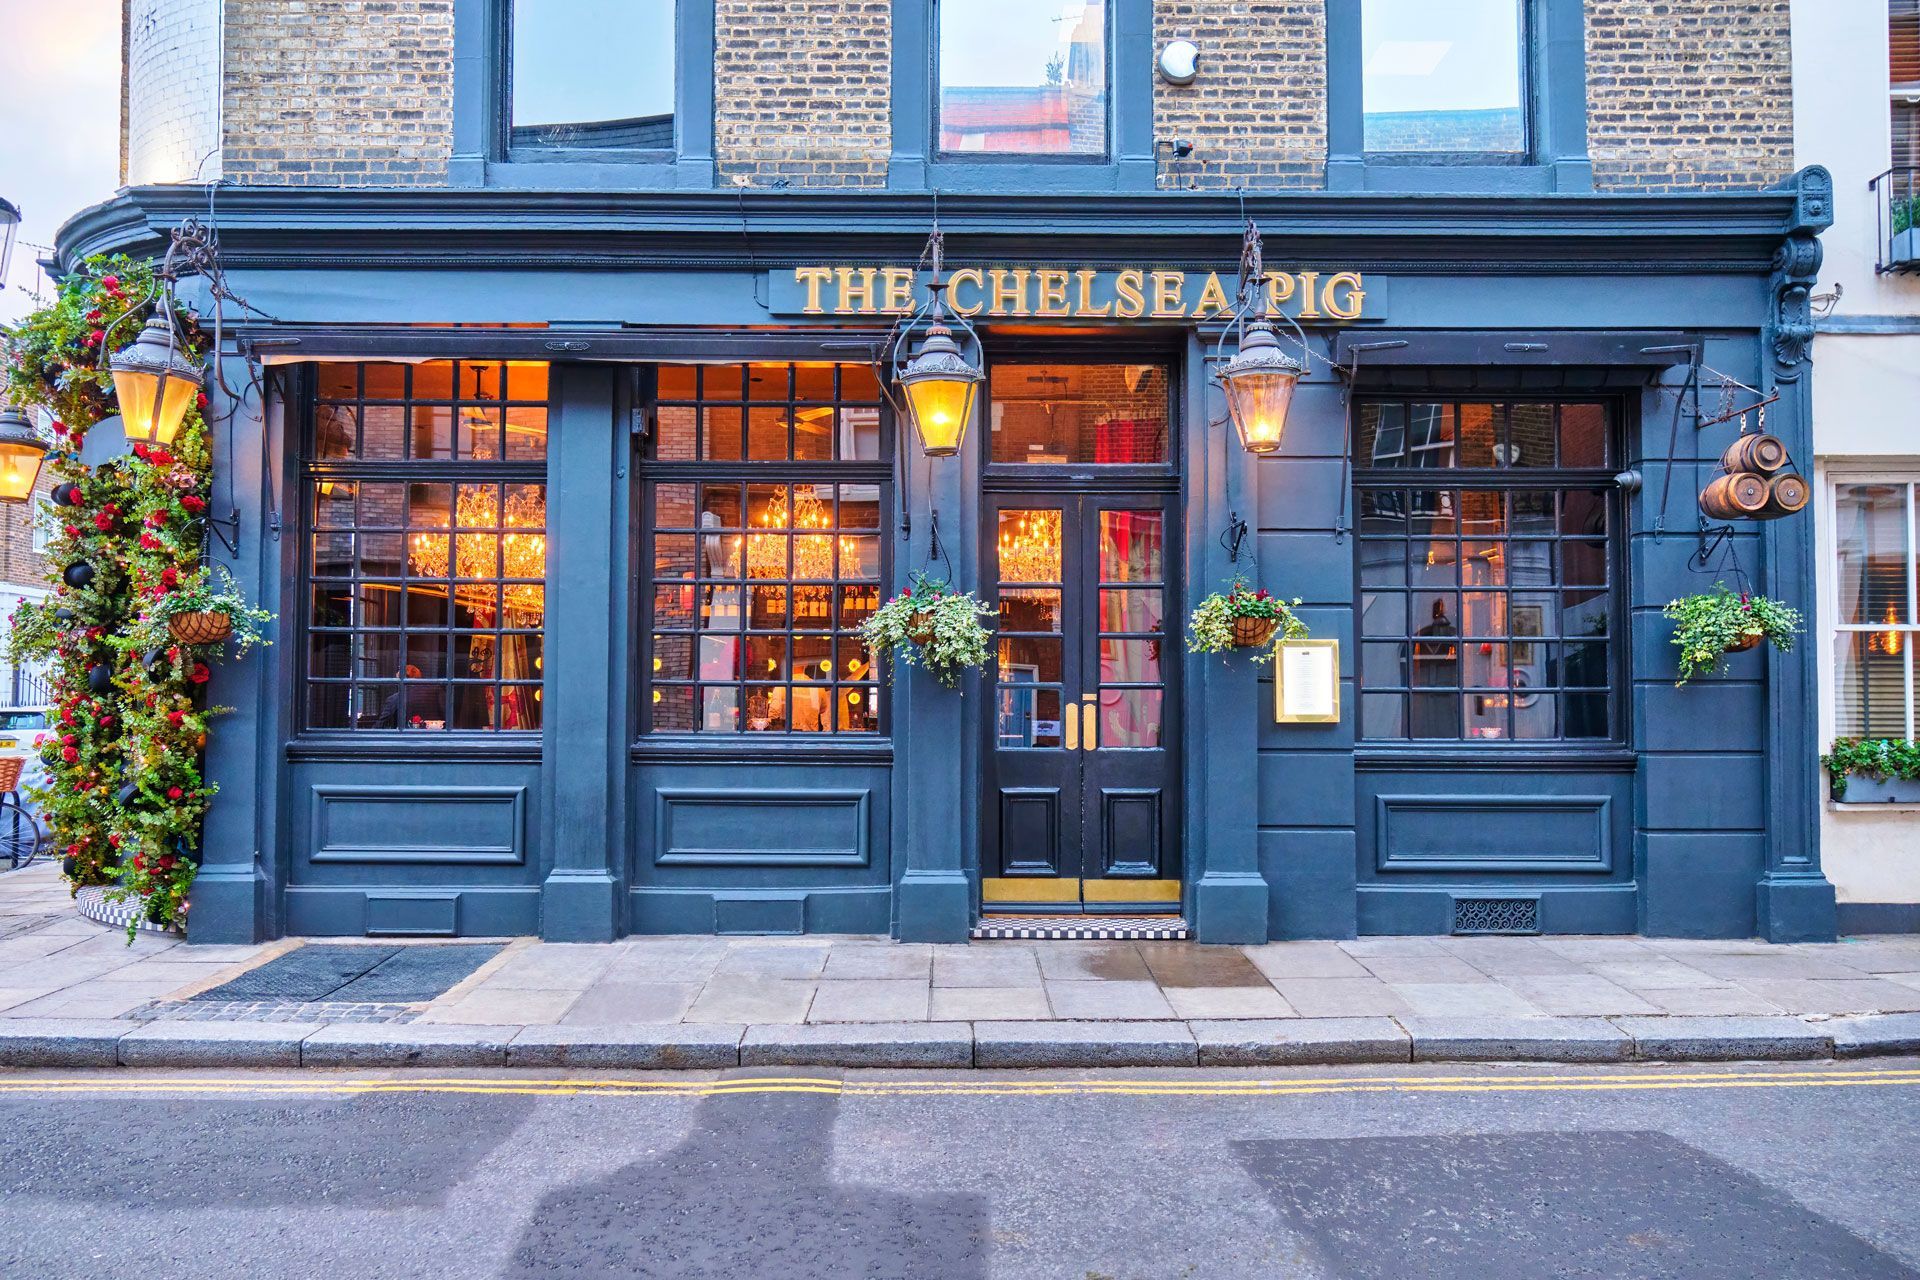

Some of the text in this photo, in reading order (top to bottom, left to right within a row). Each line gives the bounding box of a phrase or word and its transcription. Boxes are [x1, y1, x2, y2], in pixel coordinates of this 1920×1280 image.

[796, 267, 1366, 319] THE CHELSEA PIG
